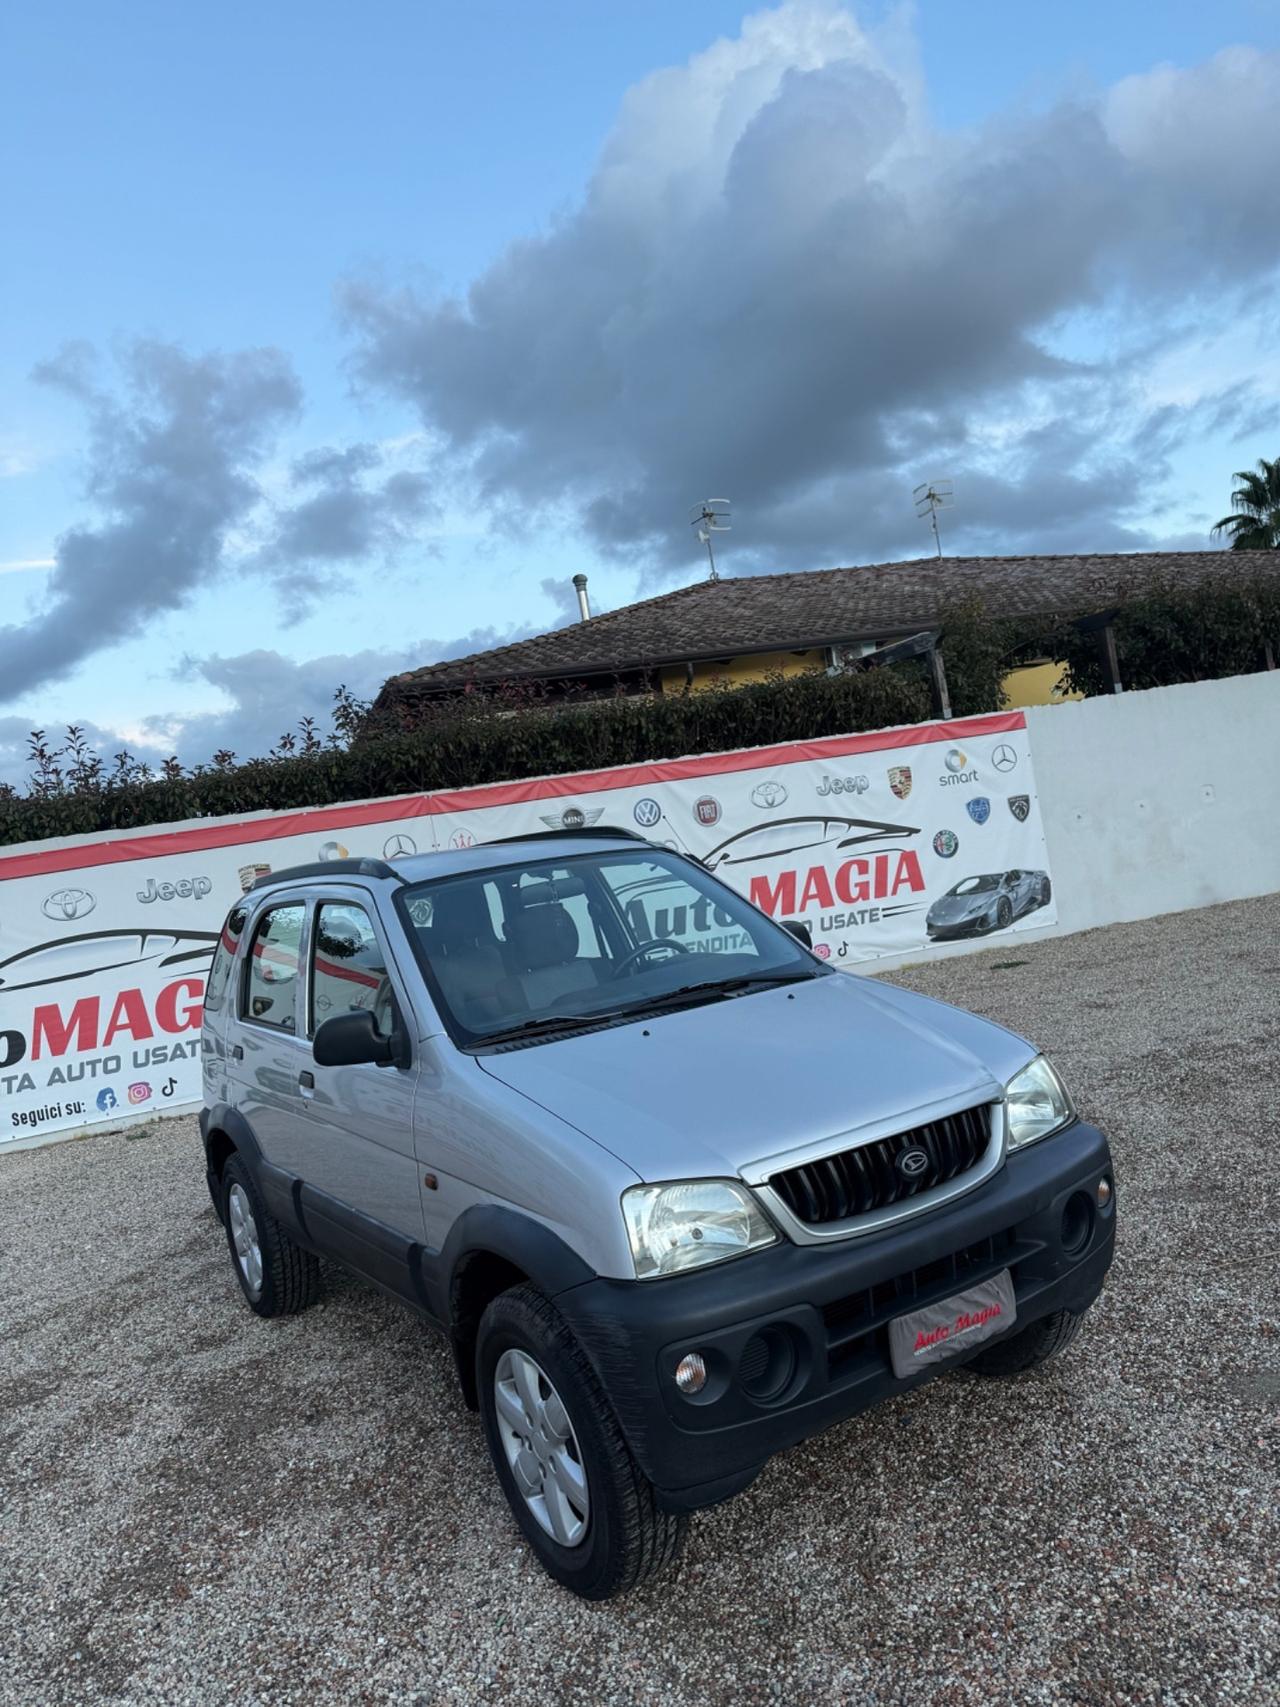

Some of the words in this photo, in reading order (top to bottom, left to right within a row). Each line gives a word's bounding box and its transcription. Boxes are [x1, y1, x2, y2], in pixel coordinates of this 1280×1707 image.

[816, 774, 870, 796] Jeep
[939, 769, 979, 786] smart
[136, 875, 212, 904] Jeep
[684, 932, 753, 953] ENDITA
[820, 907, 880, 932] USATE
[47, 1055, 121, 1087] AUTO
[12, 1102, 62, 1127] Seguici
[66, 1100, 86, 1117] su:
[914, 1326, 950, 1352] Auto
[954, 1303, 1001, 1333] Magia
